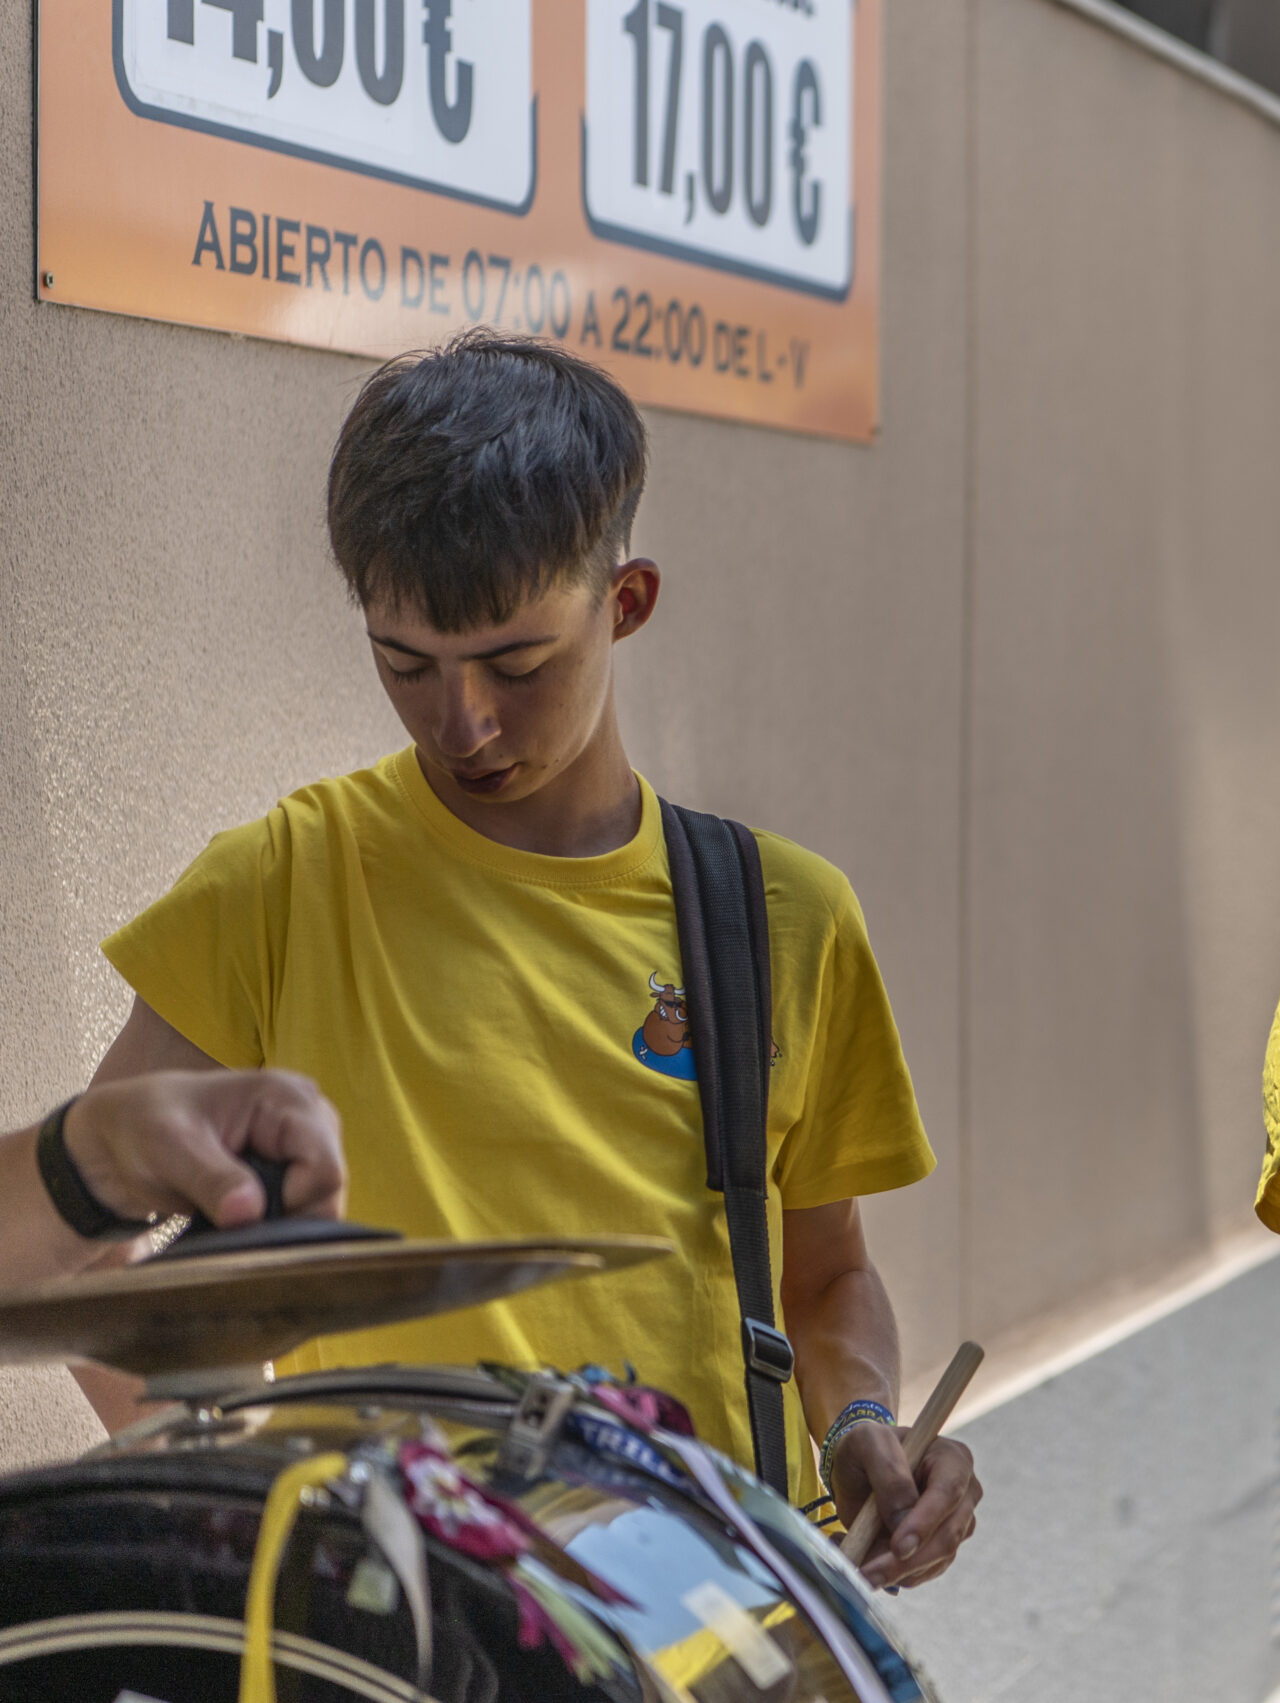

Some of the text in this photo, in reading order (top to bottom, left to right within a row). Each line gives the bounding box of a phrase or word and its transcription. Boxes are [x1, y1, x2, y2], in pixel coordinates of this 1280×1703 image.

[191, 200, 387, 301] ABIERTO
[400, 245, 450, 316] DE
[461, 249, 572, 339] 07:00
[580, 290, 603, 348] A
[611, 287, 707, 369] 22:00
